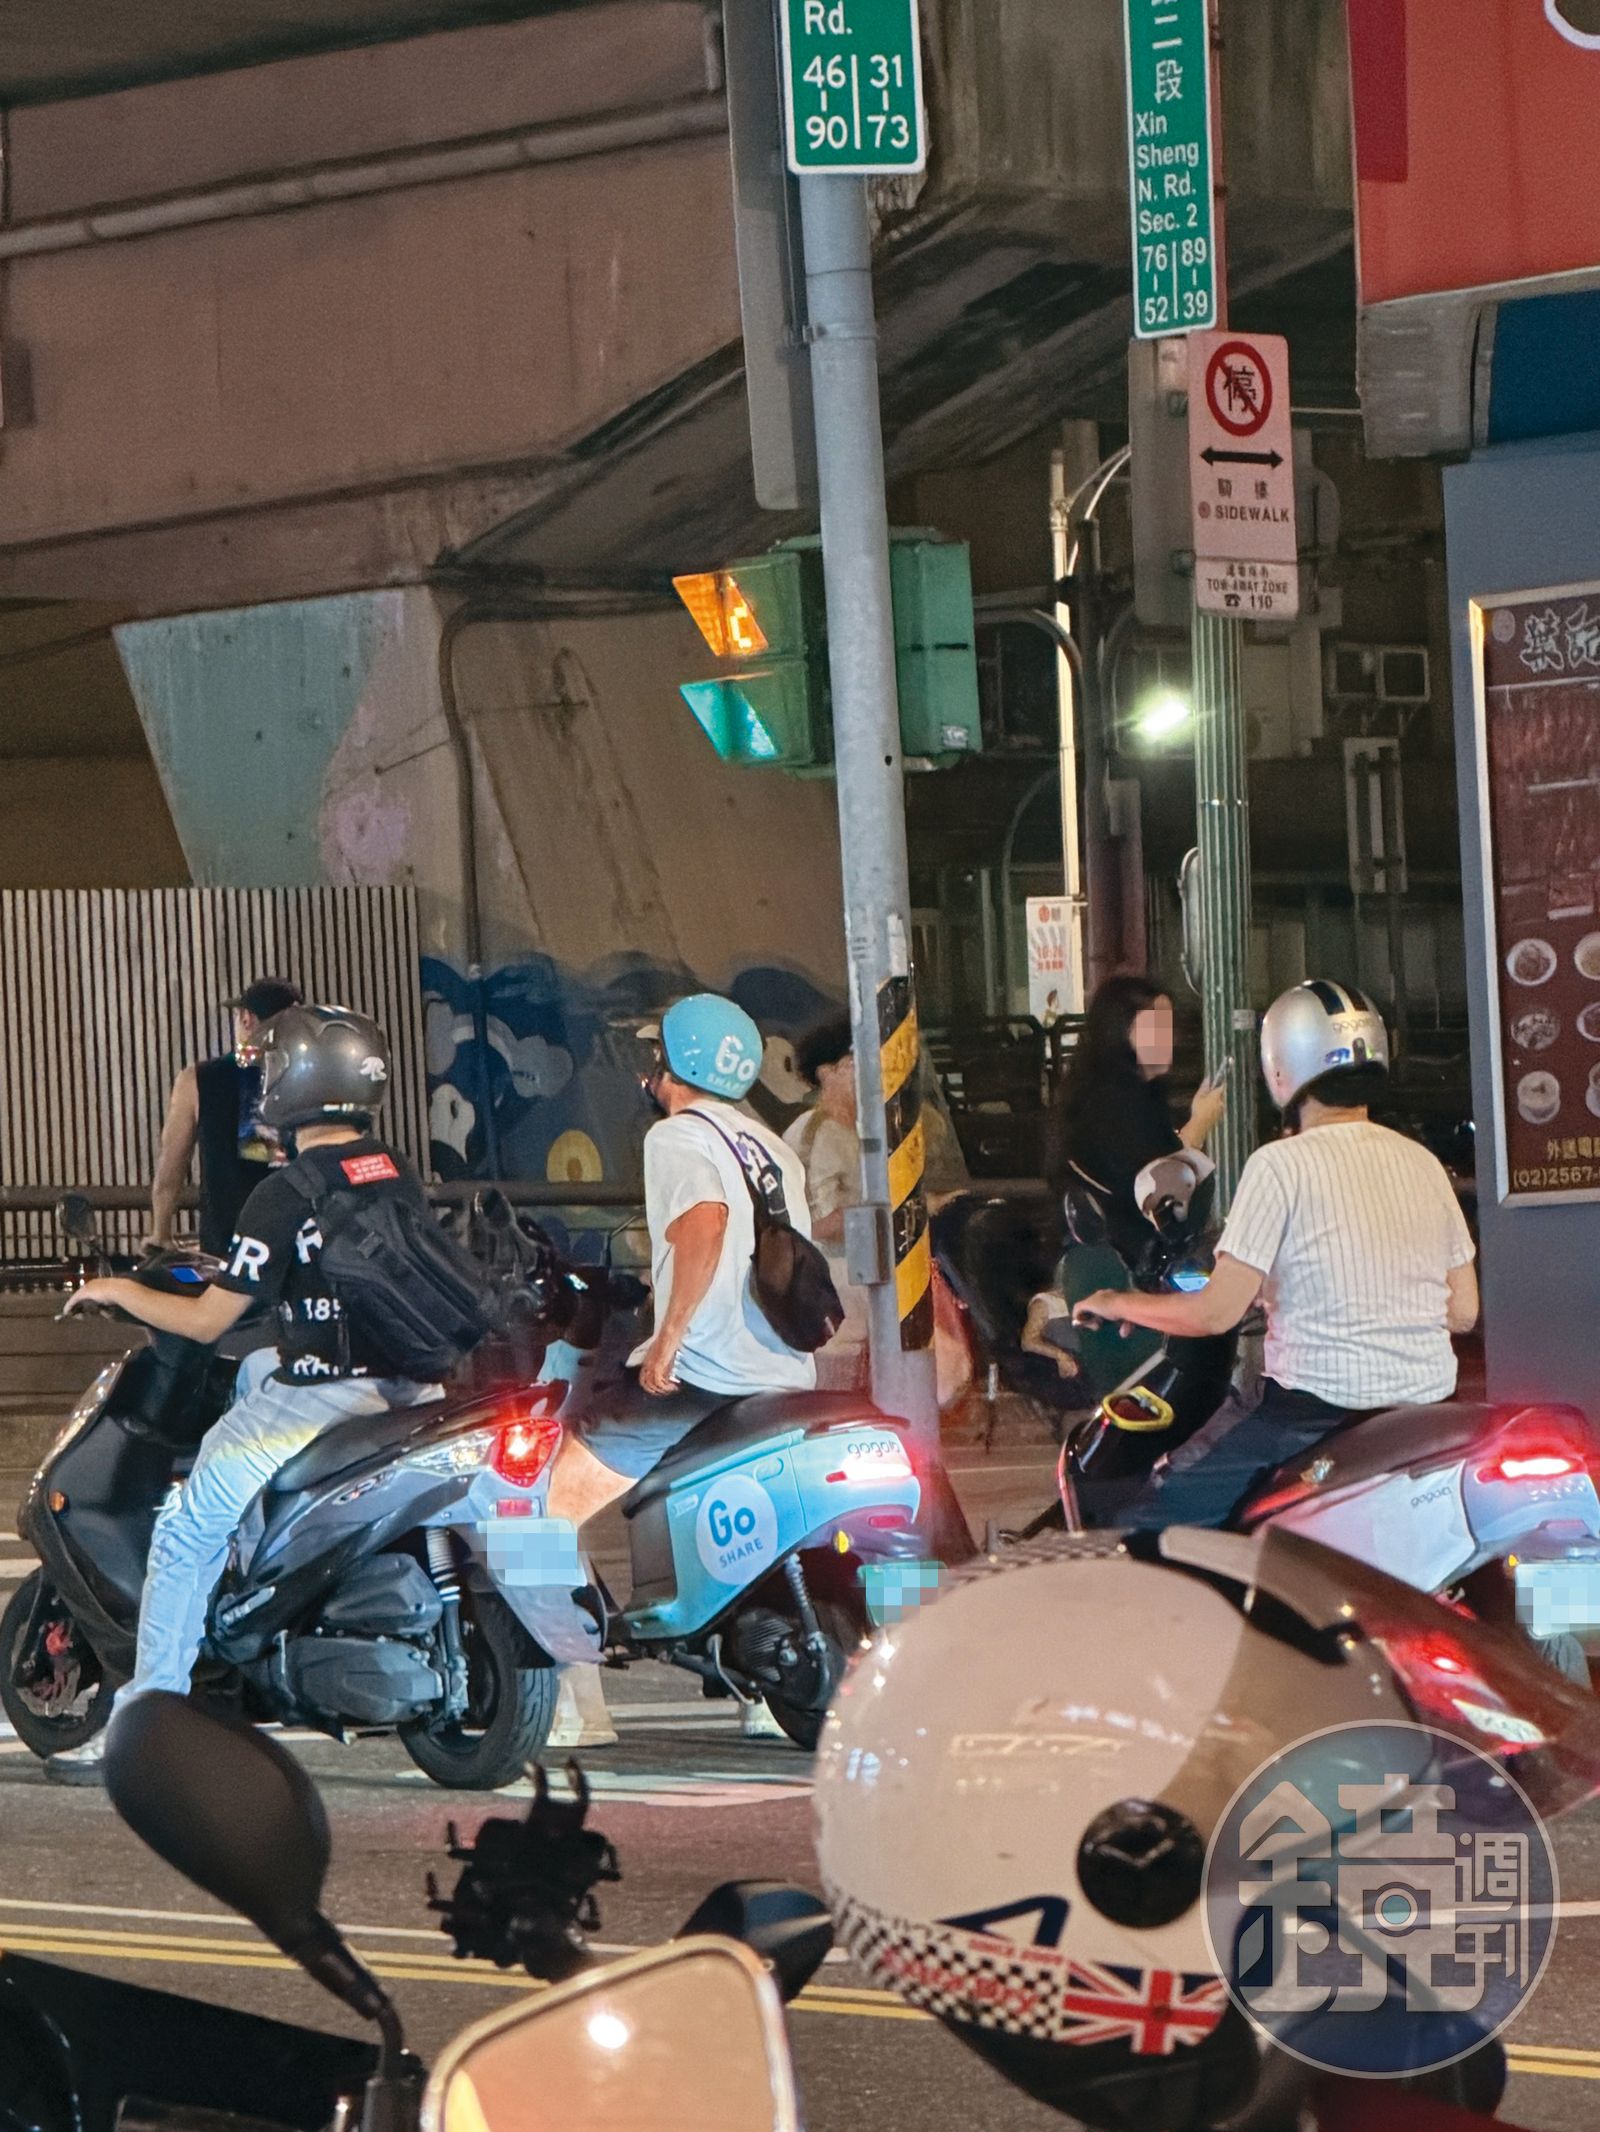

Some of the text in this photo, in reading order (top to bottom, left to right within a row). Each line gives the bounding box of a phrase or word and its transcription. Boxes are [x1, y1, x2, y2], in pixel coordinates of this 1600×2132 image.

[804, 0, 853, 35] Rd.
[1150, 0, 1184, 104] 二段
[803, 54, 902, 89] 46 31
[806, 115, 909, 149] 90 73
[1136, 110, 1168, 137] Xin
[1137, 142, 1199, 169] Sheng
[1139, 170, 1197, 202] N. Rd.
[1140, 202, 1198, 235] Sec. 2
[1142, 236, 1206, 273] 76 89
[1144, 289, 1208, 325] 52 39
[1215, 504, 1290, 523] SIDEWALK
[1250, 594, 1273, 609] 110
[715, 1035, 756, 1082] Go
[1513, 1166, 1600, 1188] (02)2567-
[709, 1499, 756, 1547] Go
[719, 1537, 764, 1568] SHARE
